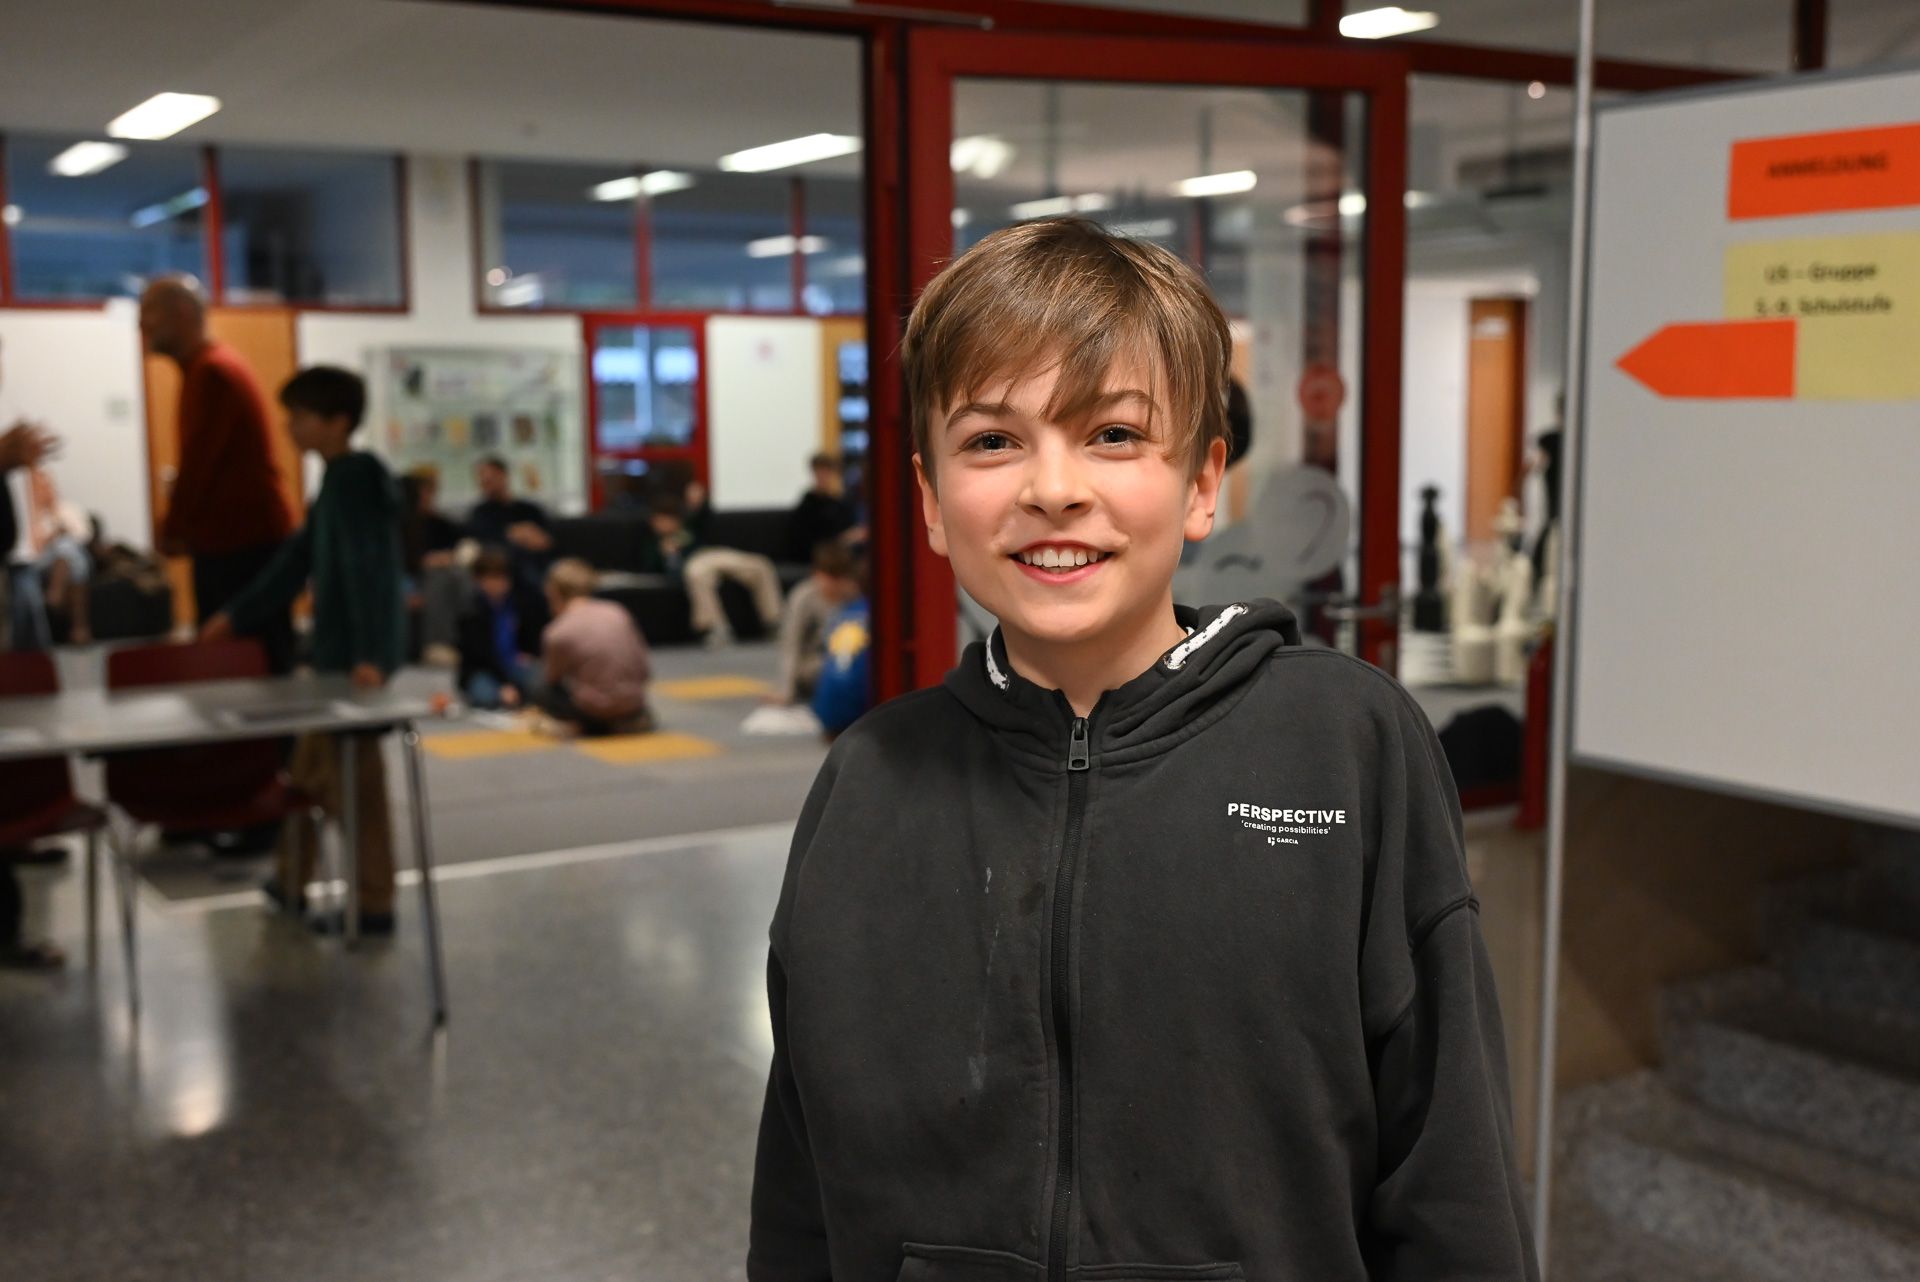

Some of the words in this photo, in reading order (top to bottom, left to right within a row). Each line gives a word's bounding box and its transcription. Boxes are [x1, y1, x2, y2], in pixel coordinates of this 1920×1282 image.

[1766, 152, 1889, 177] ANMELDUNG
[1808, 261, 1878, 283] Gruppe
[1798, 293, 1894, 315] Schulstufe
[1227, 802, 1346, 824] PERSPECTIVE
[1276, 837, 1299, 845] GARCIA
